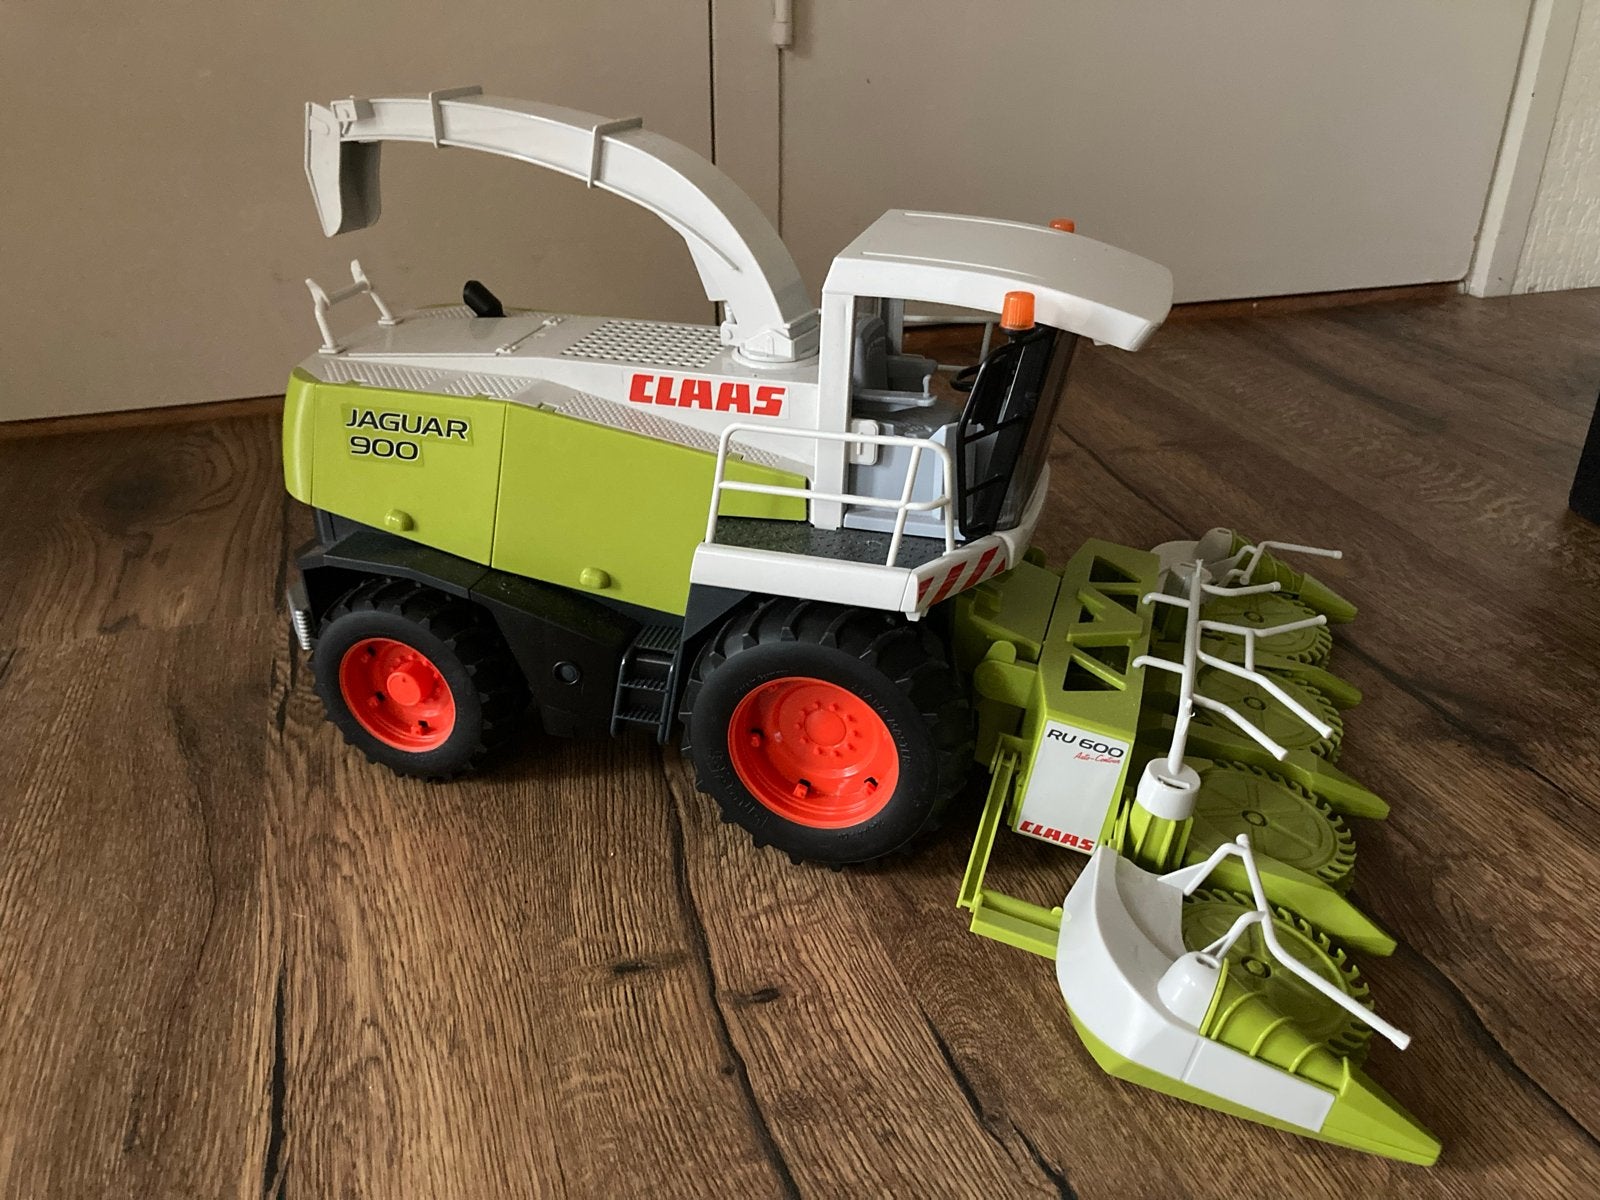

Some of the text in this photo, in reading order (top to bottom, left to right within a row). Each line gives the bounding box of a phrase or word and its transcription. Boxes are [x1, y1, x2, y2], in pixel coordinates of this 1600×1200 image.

[629, 374, 786, 417] CLAAS
[346, 408, 469, 440] JAGUAR
[350, 435, 419, 461] 900
[1047, 729, 1124, 758] RU 600
[1019, 820, 1095, 851] CLAAS
